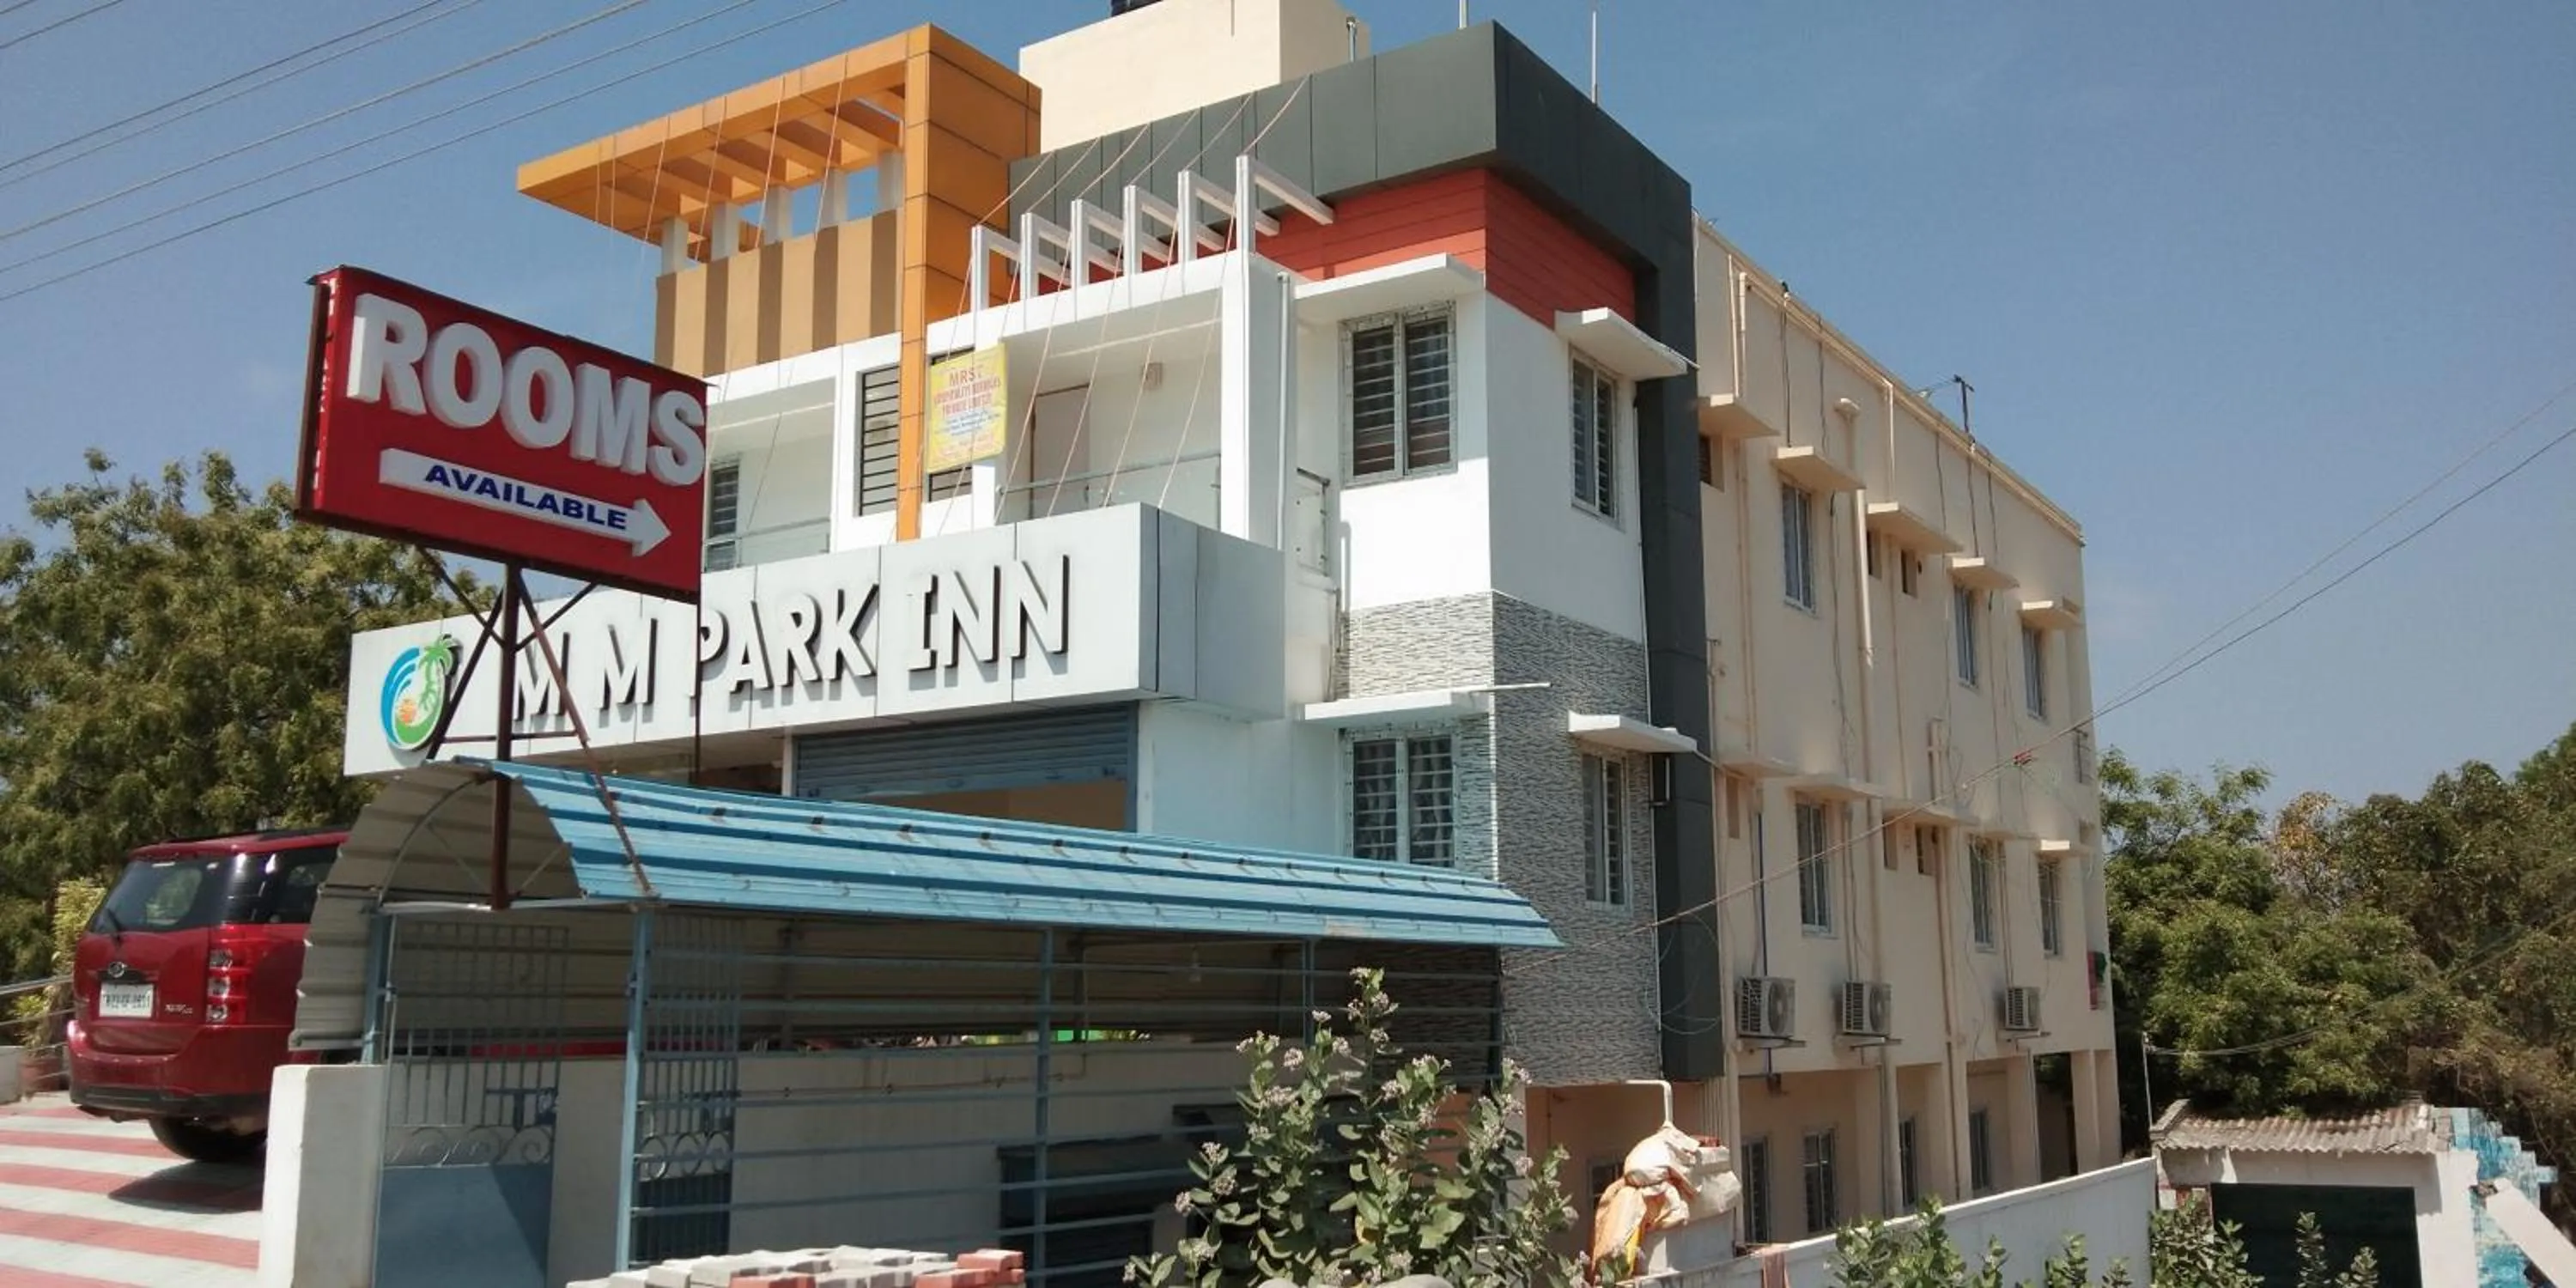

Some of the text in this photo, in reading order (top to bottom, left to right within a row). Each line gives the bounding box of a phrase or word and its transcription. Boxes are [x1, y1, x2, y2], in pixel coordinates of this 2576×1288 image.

[347, 293, 706, 486] ROOMS
[425, 465, 627, 531] AVAILABLE
[511, 554, 1070, 722] M M PARK INN
